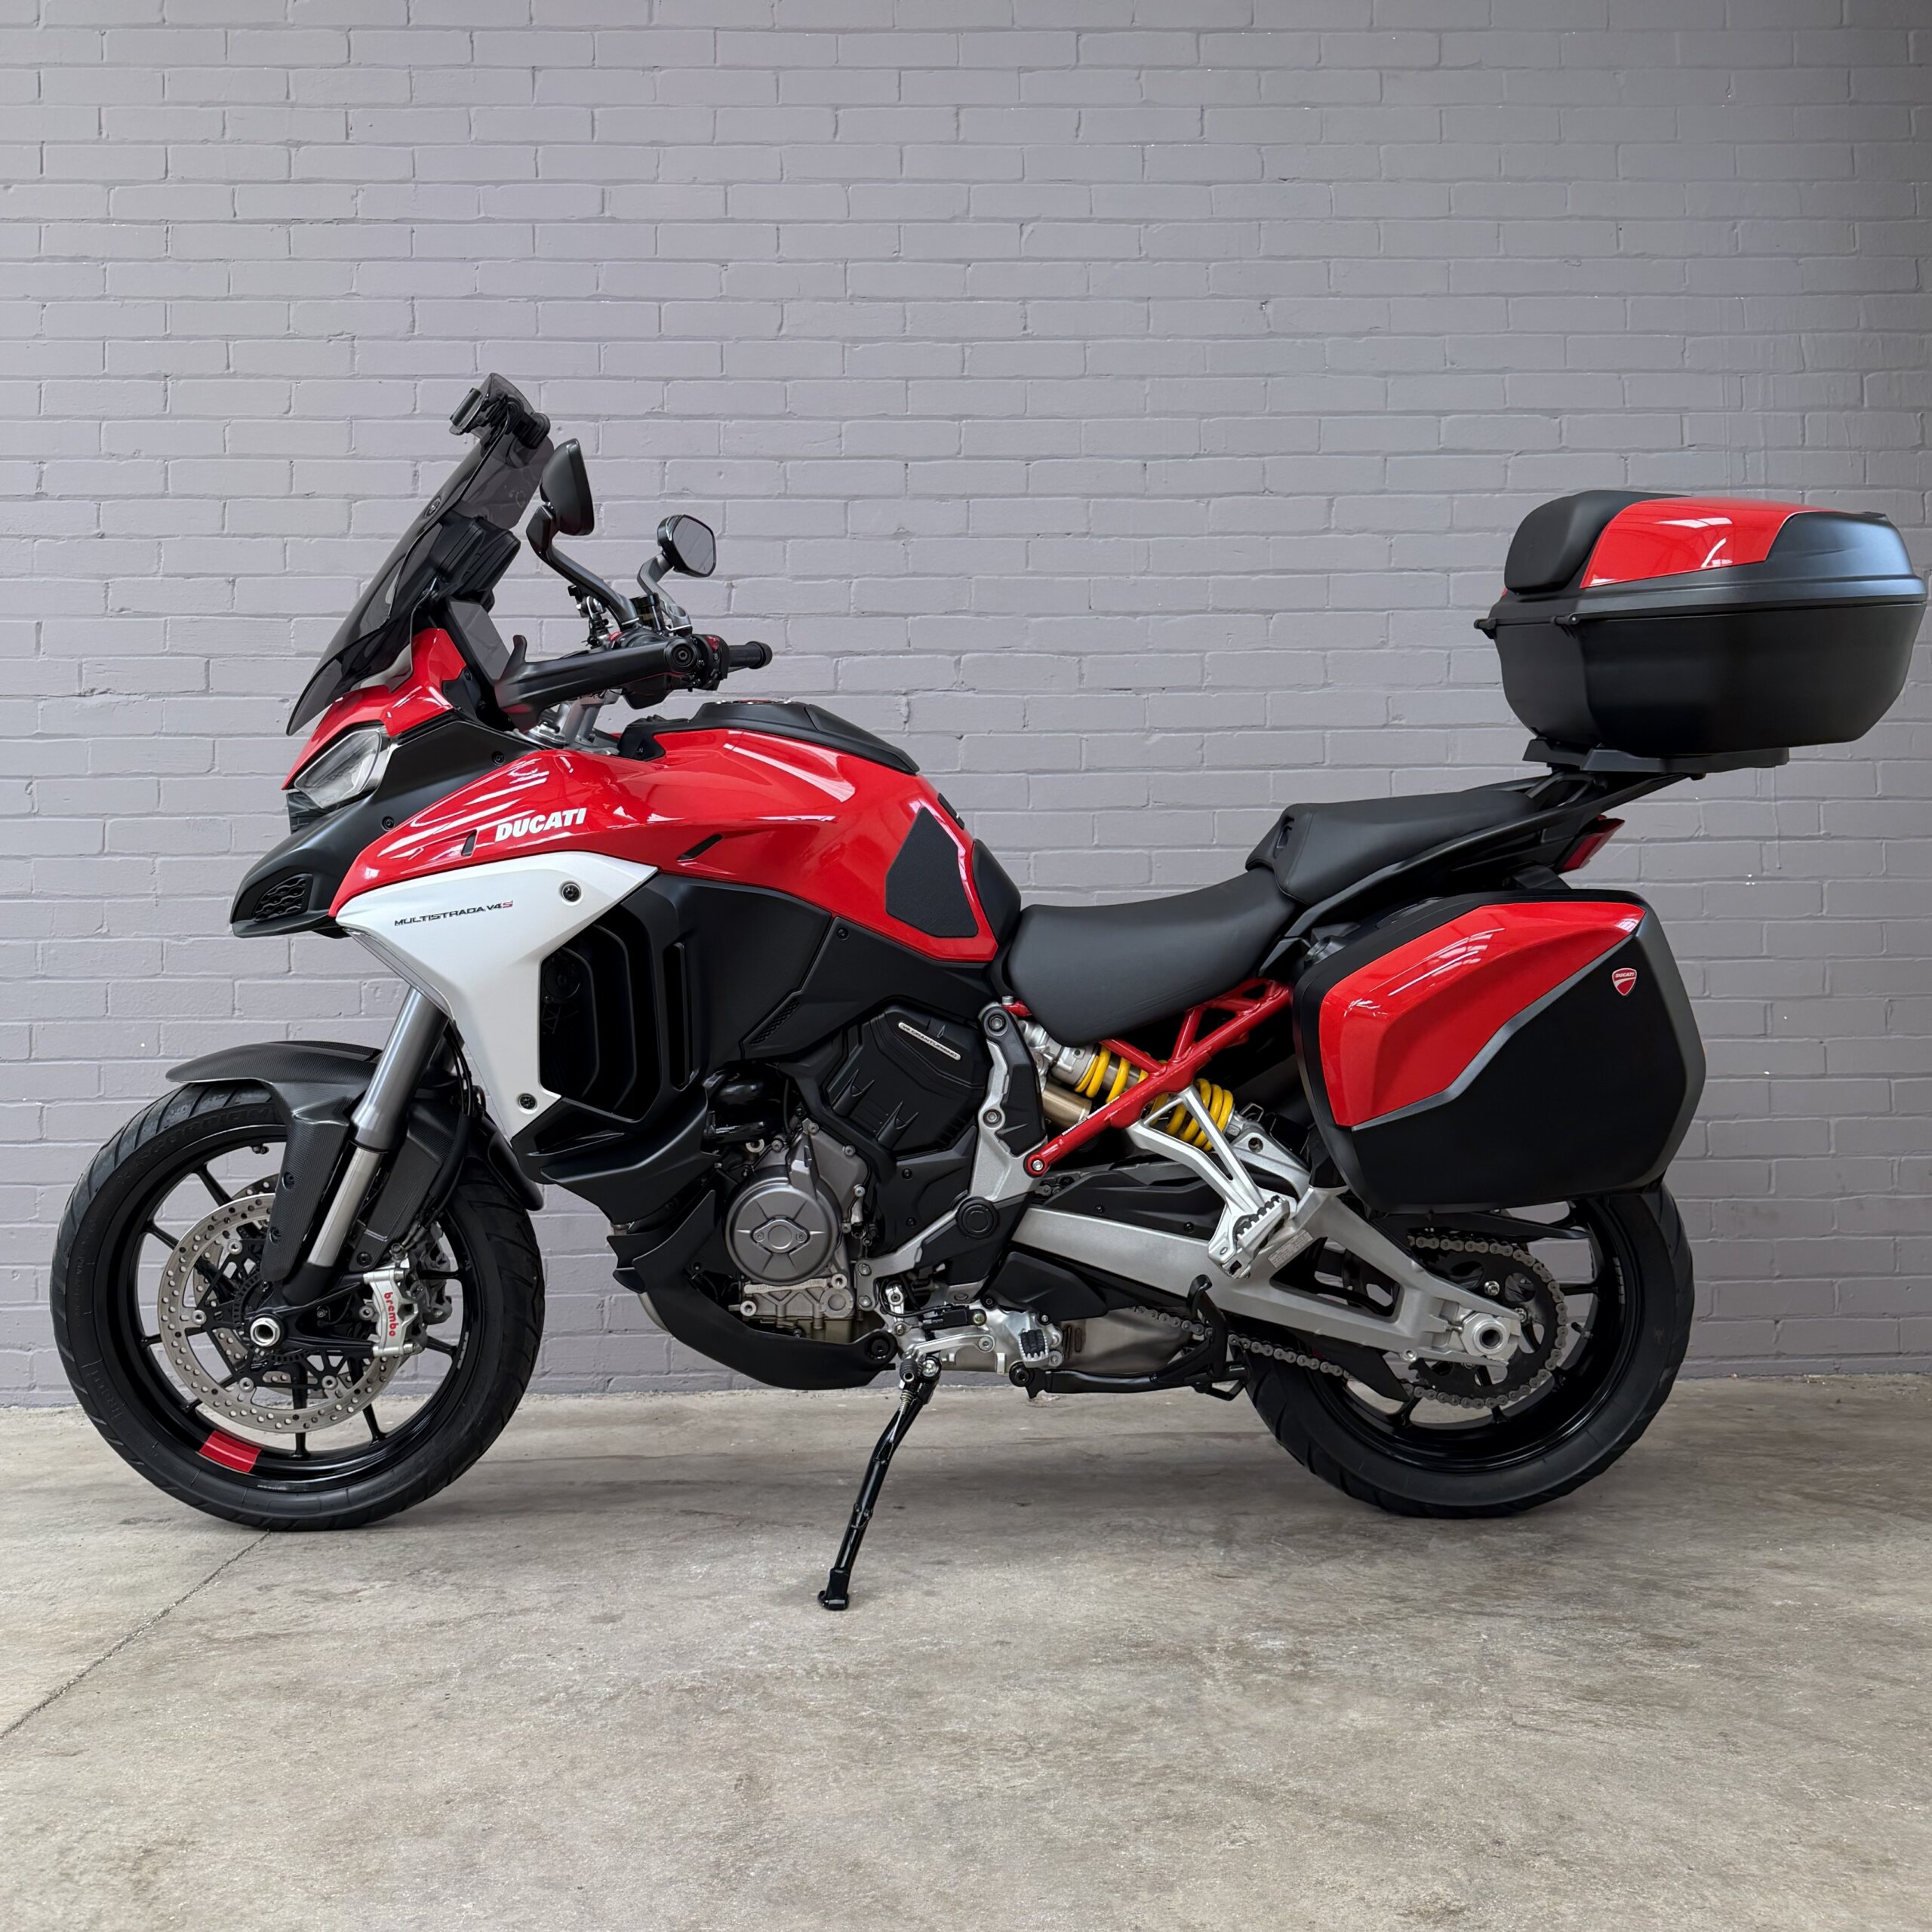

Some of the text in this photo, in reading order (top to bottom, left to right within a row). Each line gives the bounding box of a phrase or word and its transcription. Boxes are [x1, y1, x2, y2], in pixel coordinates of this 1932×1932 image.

[495, 808, 587, 842] DUCATI
[394, 906, 485, 927] MULTISTRADA
[383, 1291, 399, 1337] brembo
